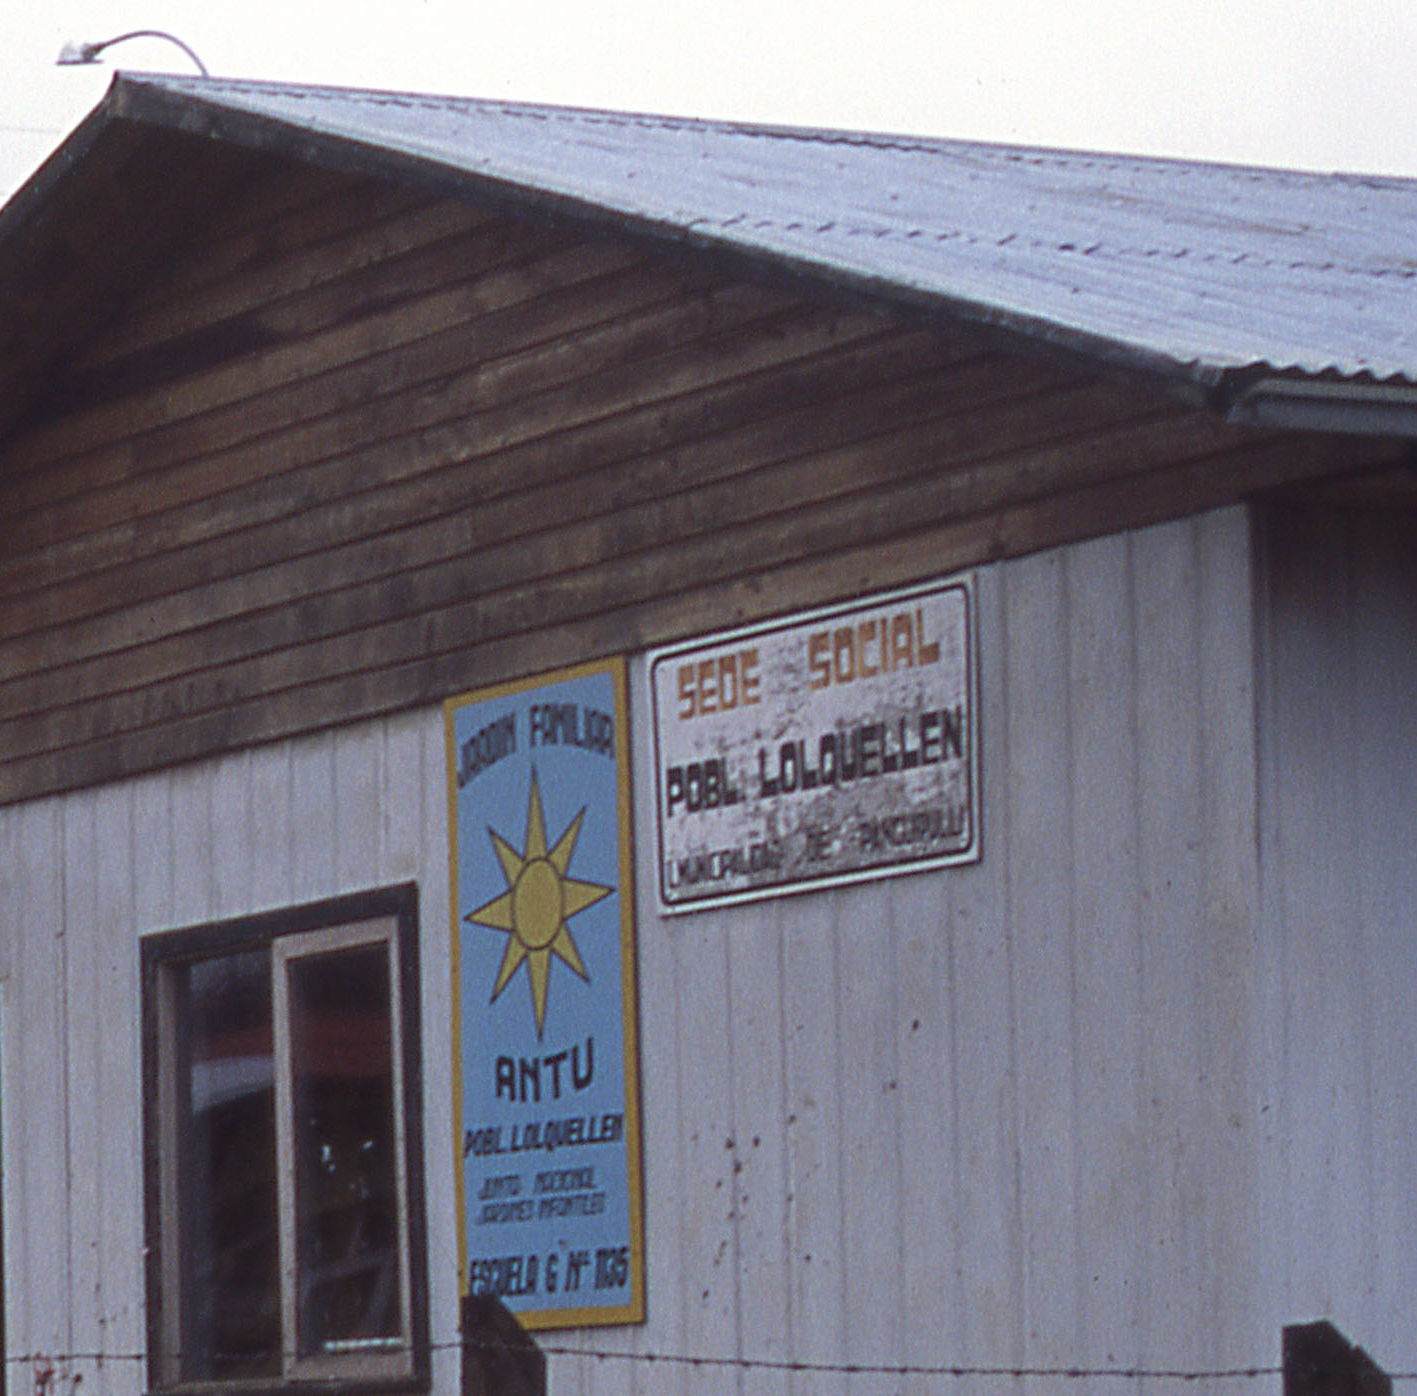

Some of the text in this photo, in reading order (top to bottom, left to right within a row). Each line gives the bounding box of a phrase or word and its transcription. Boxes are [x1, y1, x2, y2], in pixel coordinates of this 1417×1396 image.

[678, 609, 941, 720] SEDE SOCIAL
[529, 702, 615, 760] FAMILIAR
[760, 708, 962, 799] LOLQUELLEN
[495, 1037, 595, 1102] ANTU
[511, 1113, 624, 1152] LOLQUELLEN
[470, 1256, 538, 1296] ESCUELA
